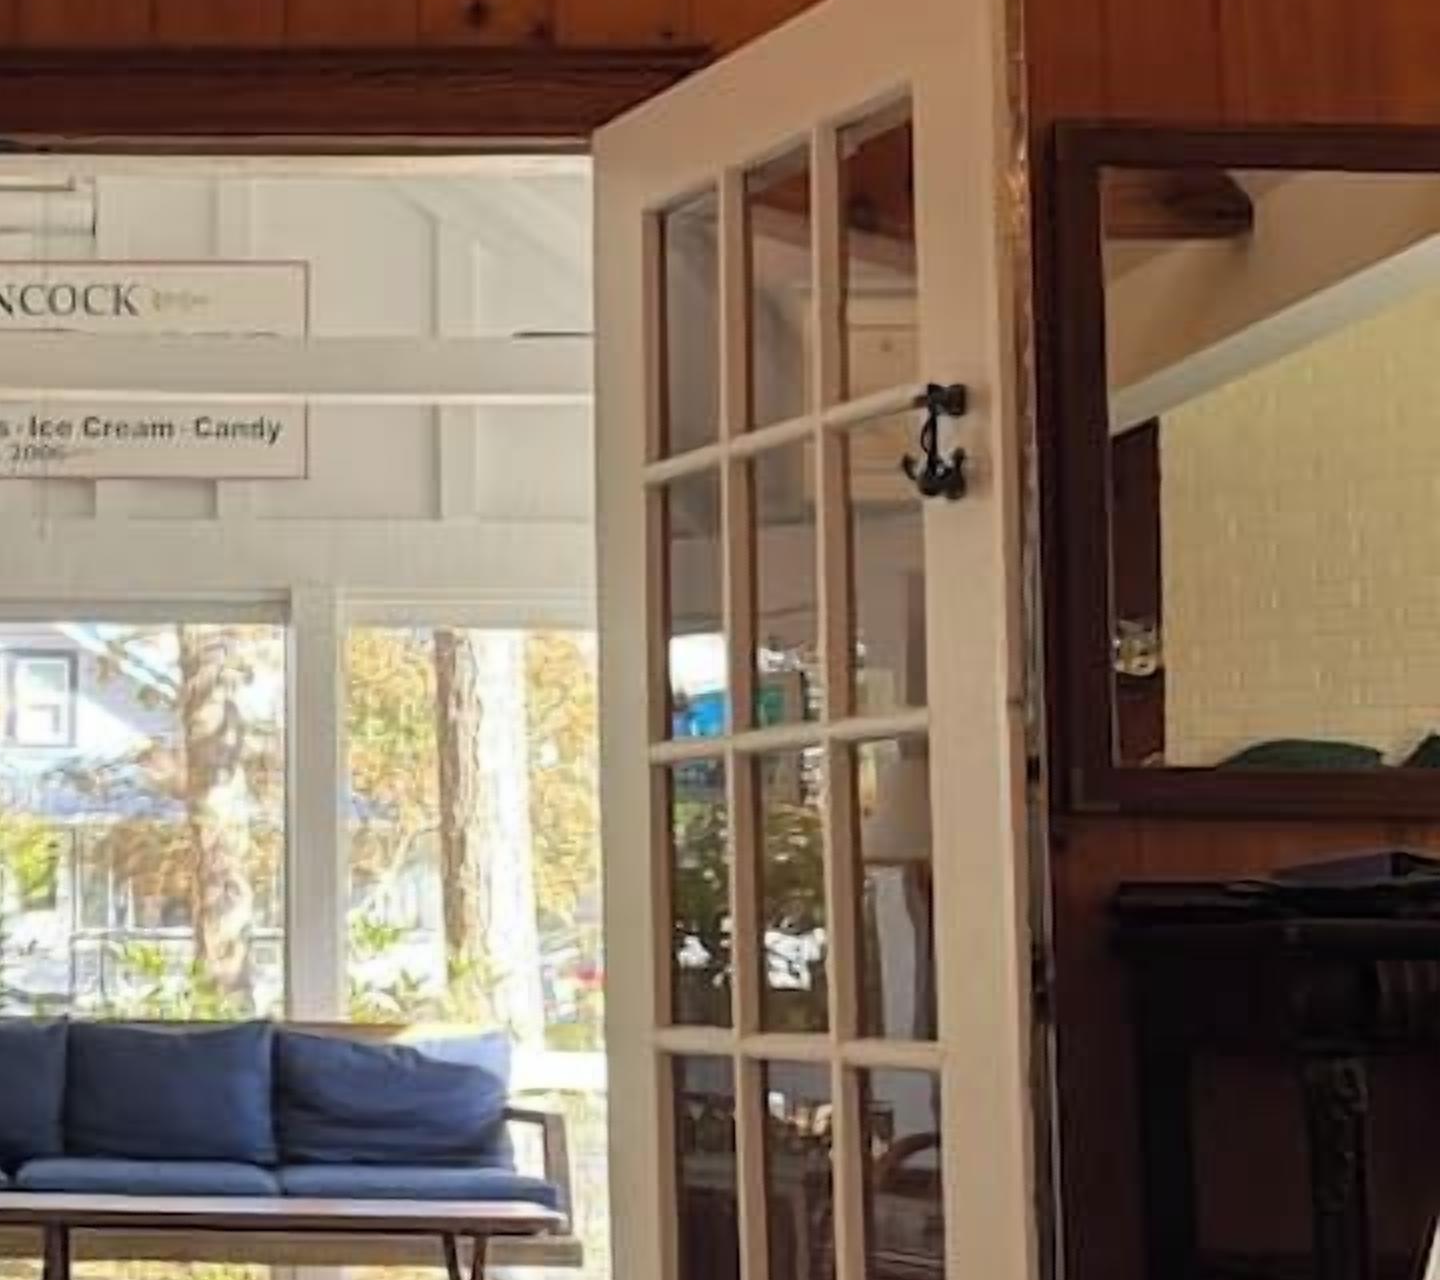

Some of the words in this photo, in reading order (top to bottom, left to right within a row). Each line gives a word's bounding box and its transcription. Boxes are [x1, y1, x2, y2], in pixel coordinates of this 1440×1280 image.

[30, 415, 72, 436] Ice
[84, 416, 175, 438] Cream
[195, 415, 282, 444] Candy
